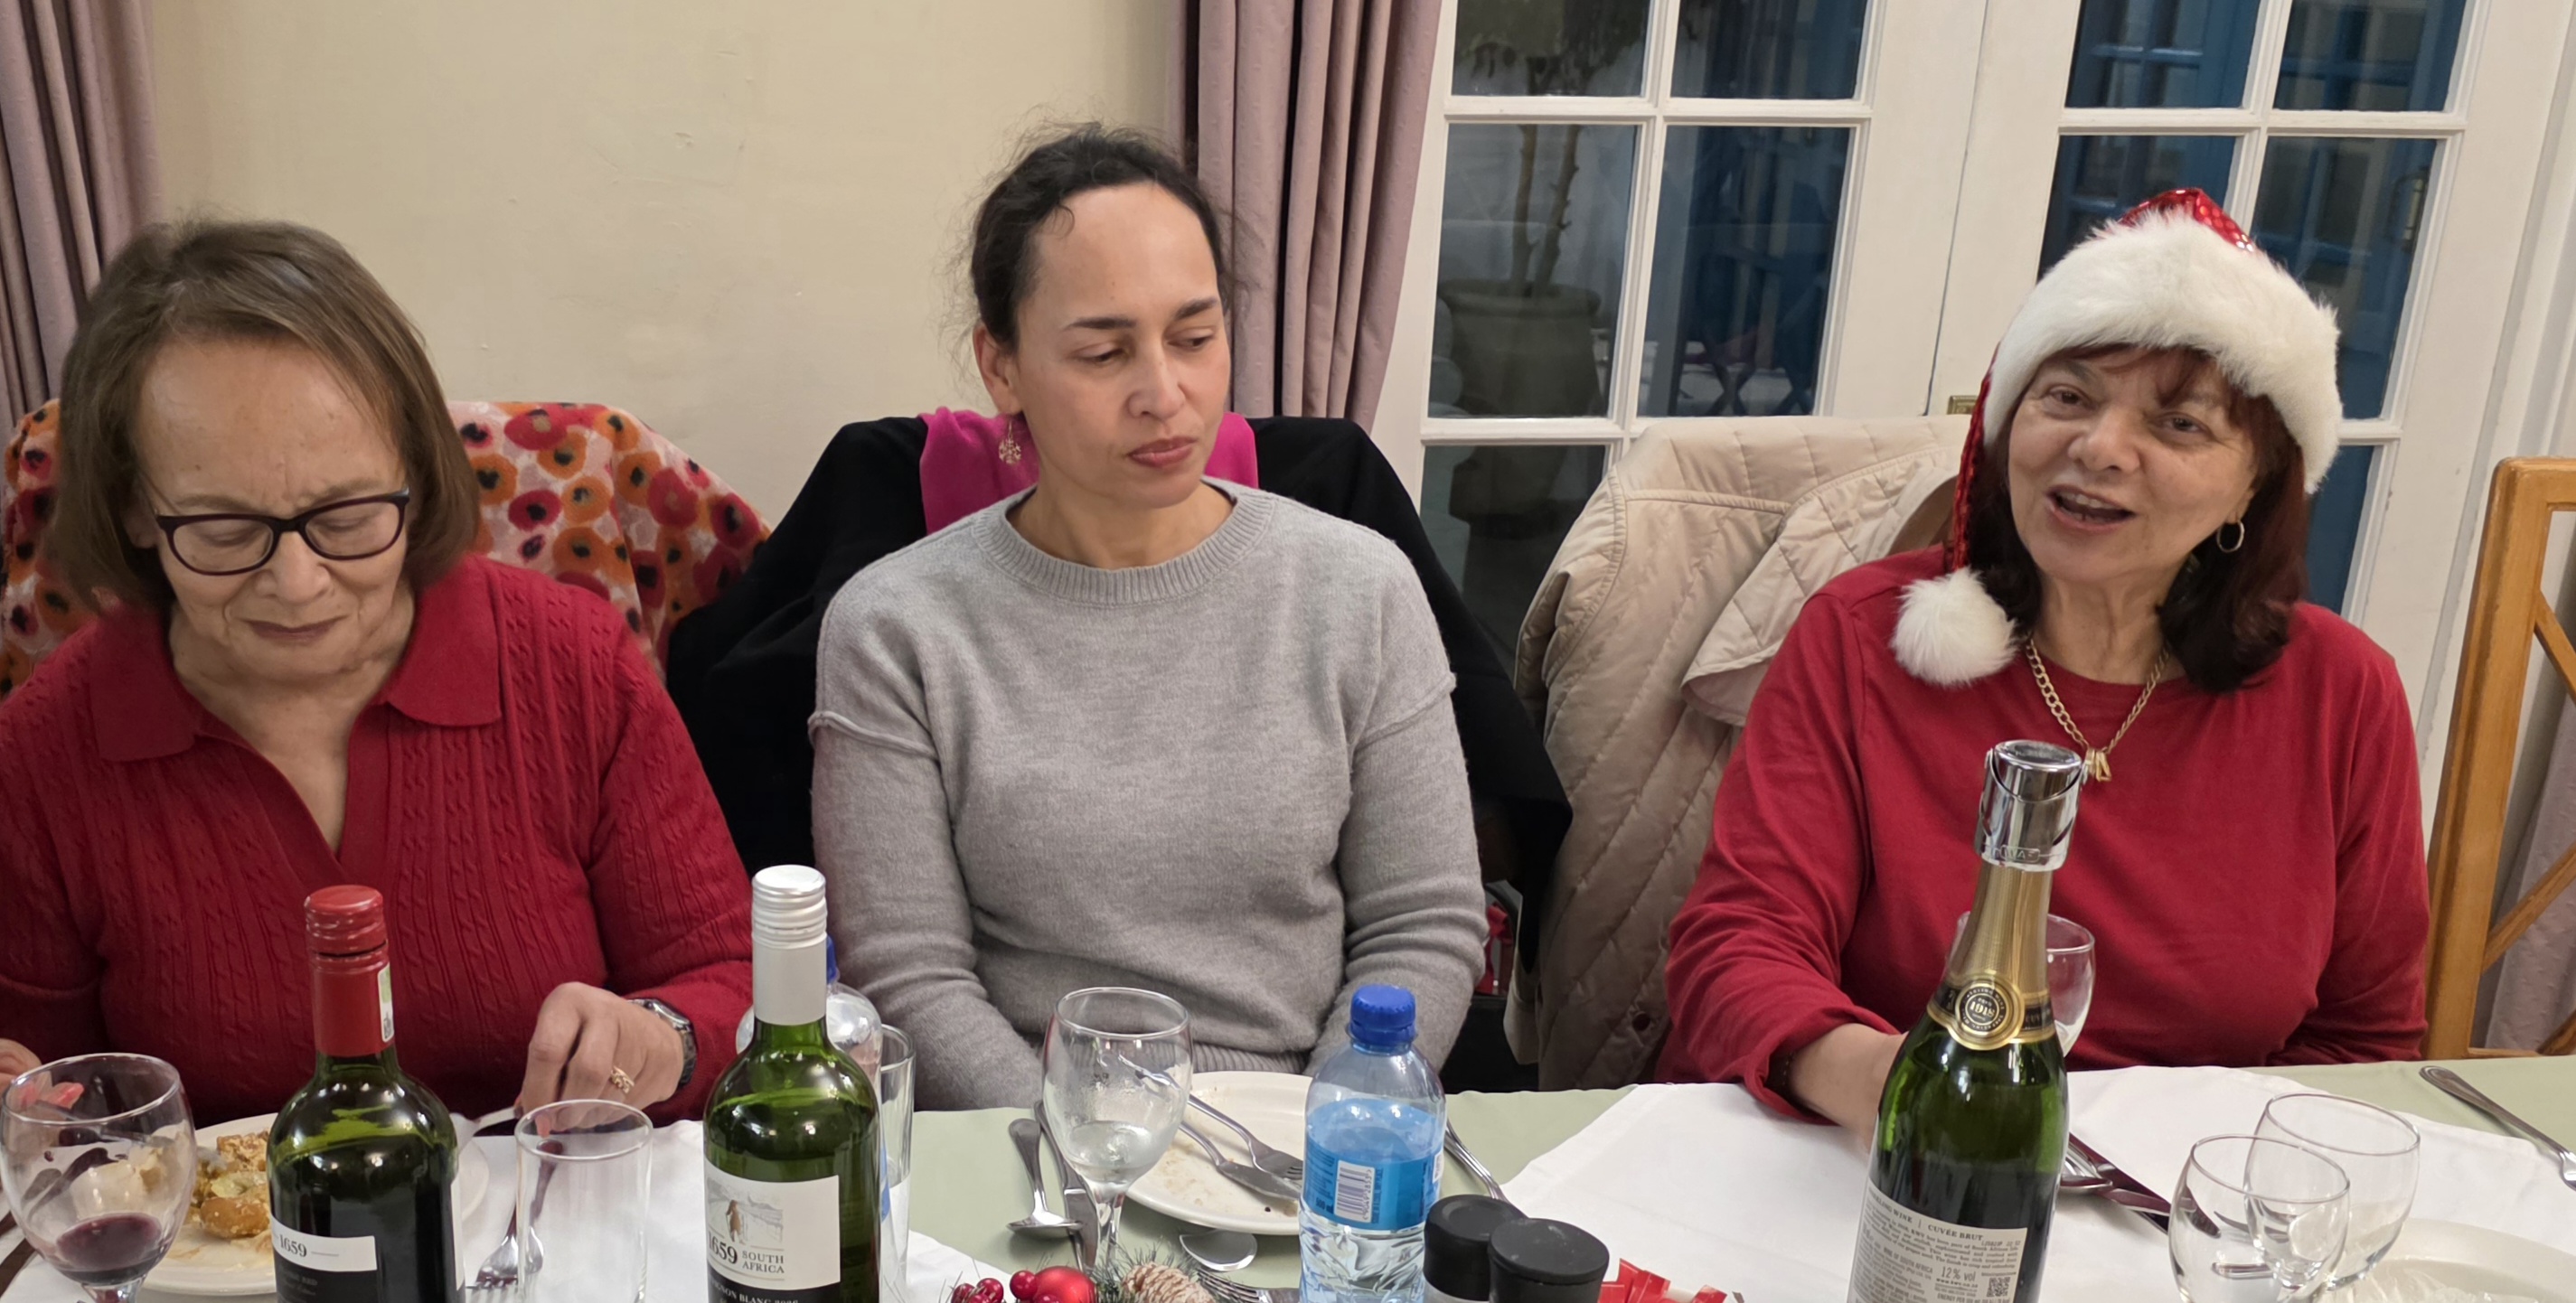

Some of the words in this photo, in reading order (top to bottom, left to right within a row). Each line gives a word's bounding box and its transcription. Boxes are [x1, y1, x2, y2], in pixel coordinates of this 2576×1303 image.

[1970, 1001, 1996, 1017] 1918
[1894, 1208, 1913, 1223] WINE
[1927, 1223, 1958, 1238] CUVÉE
[1960, 1232, 1983, 1242] BRUT
[279, 1233, 307, 1258] 1659
[708, 1232, 738, 1264] 1659
[742, 1251, 784, 1264] SOUTH
[742, 1262, 785, 1274] AFRICA
[1963, 1270, 1976, 1281] vol
